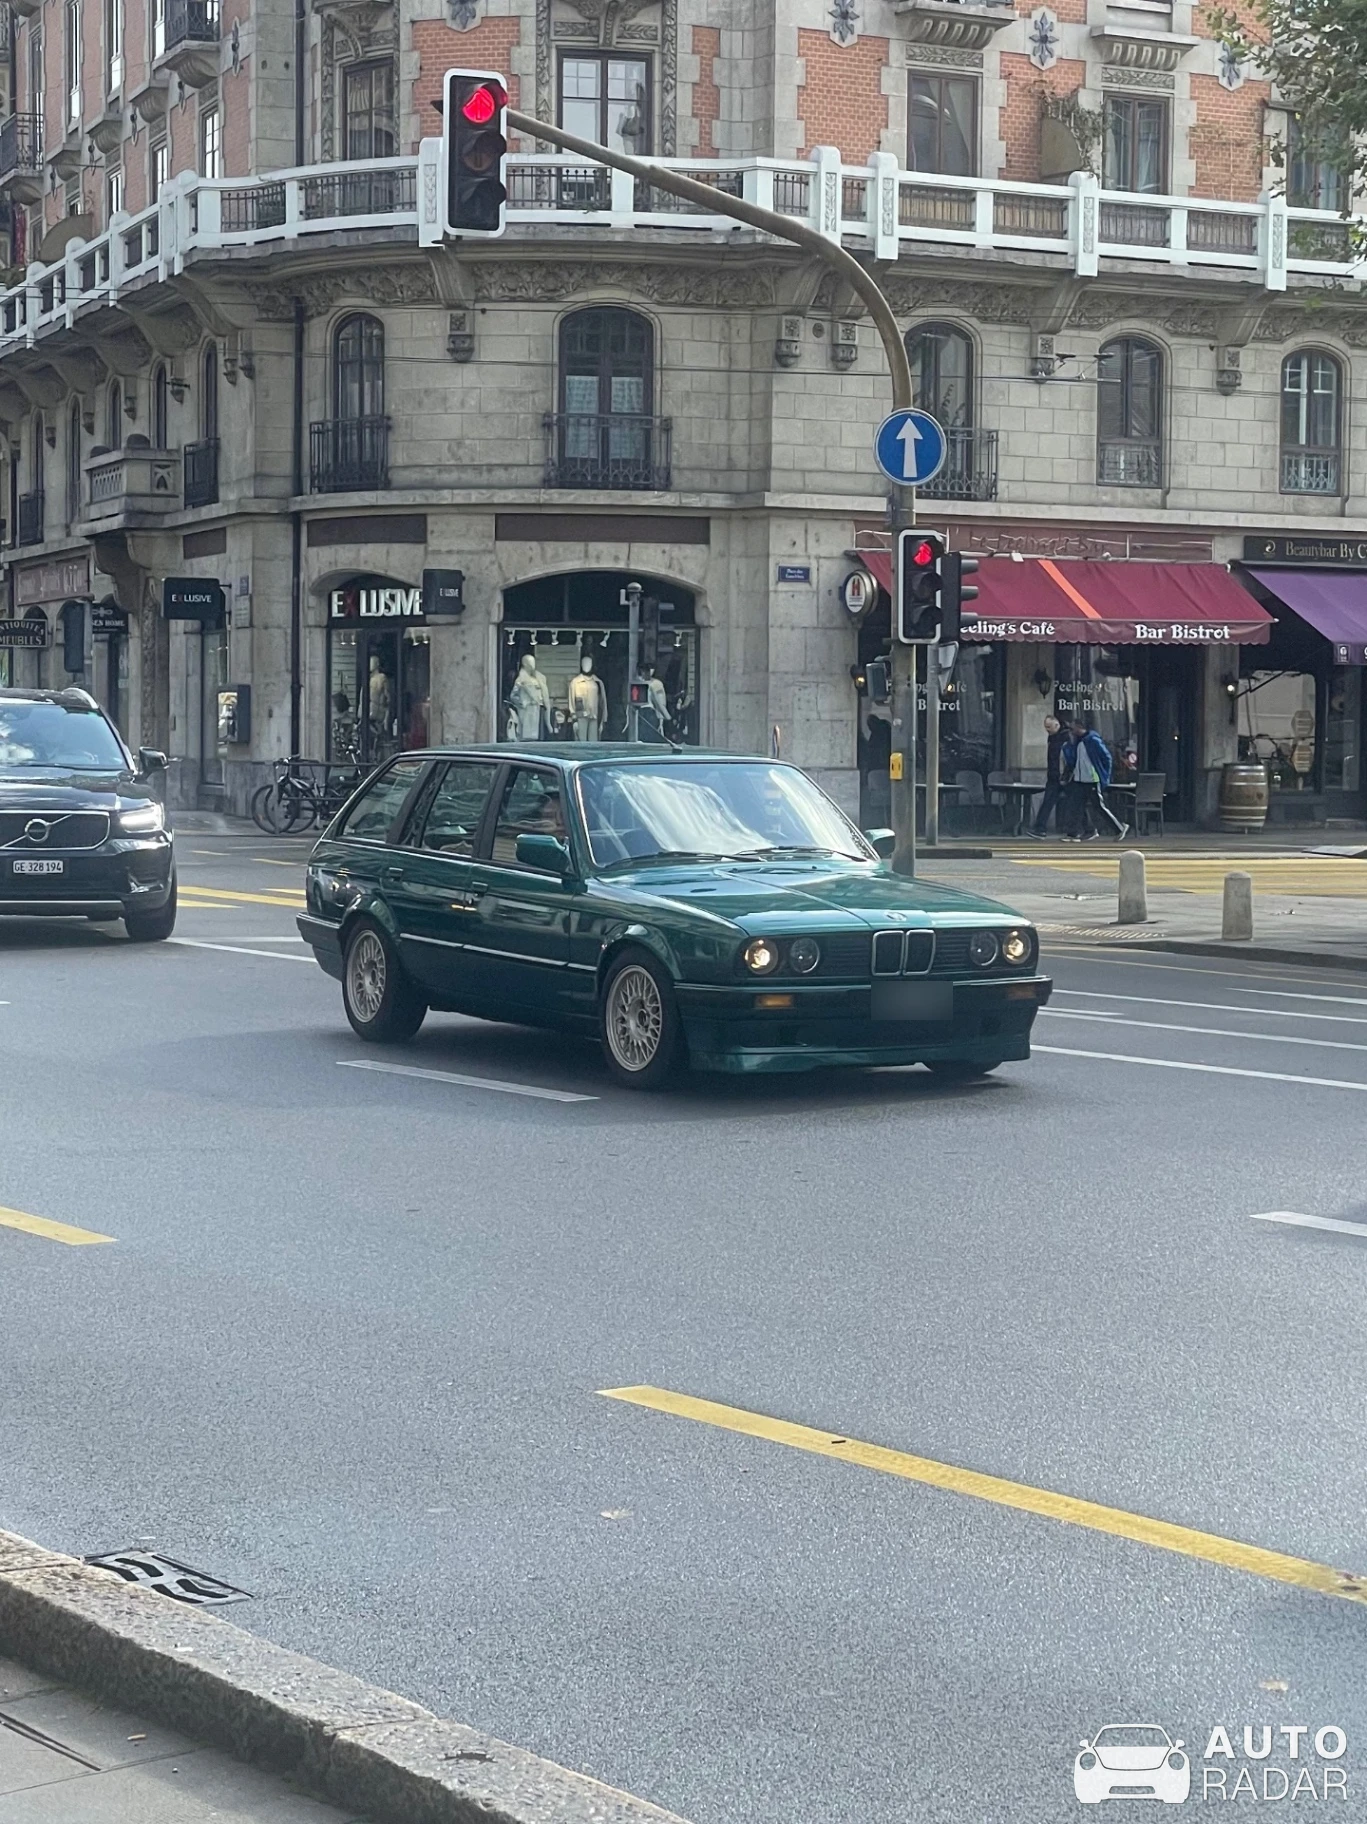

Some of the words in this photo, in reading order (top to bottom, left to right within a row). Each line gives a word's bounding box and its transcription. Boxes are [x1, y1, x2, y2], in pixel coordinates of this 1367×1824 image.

[1285, 541, 1337, 560] Beautybar
[1340, 542, 1355, 561] By
[960, 620, 1016, 637] eeling's
[1019, 621, 1055, 636] Café
[1135, 624, 1166, 639] Bar
[1171, 624, 1230, 640] Bistrot
[1058, 699, 1080, 711] Bar
[1082, 699, 1124, 711] Bistrot
[14, 862, 26, 872] GE
[28, 862, 44, 872] 328
[46, 862, 62, 872] 194
